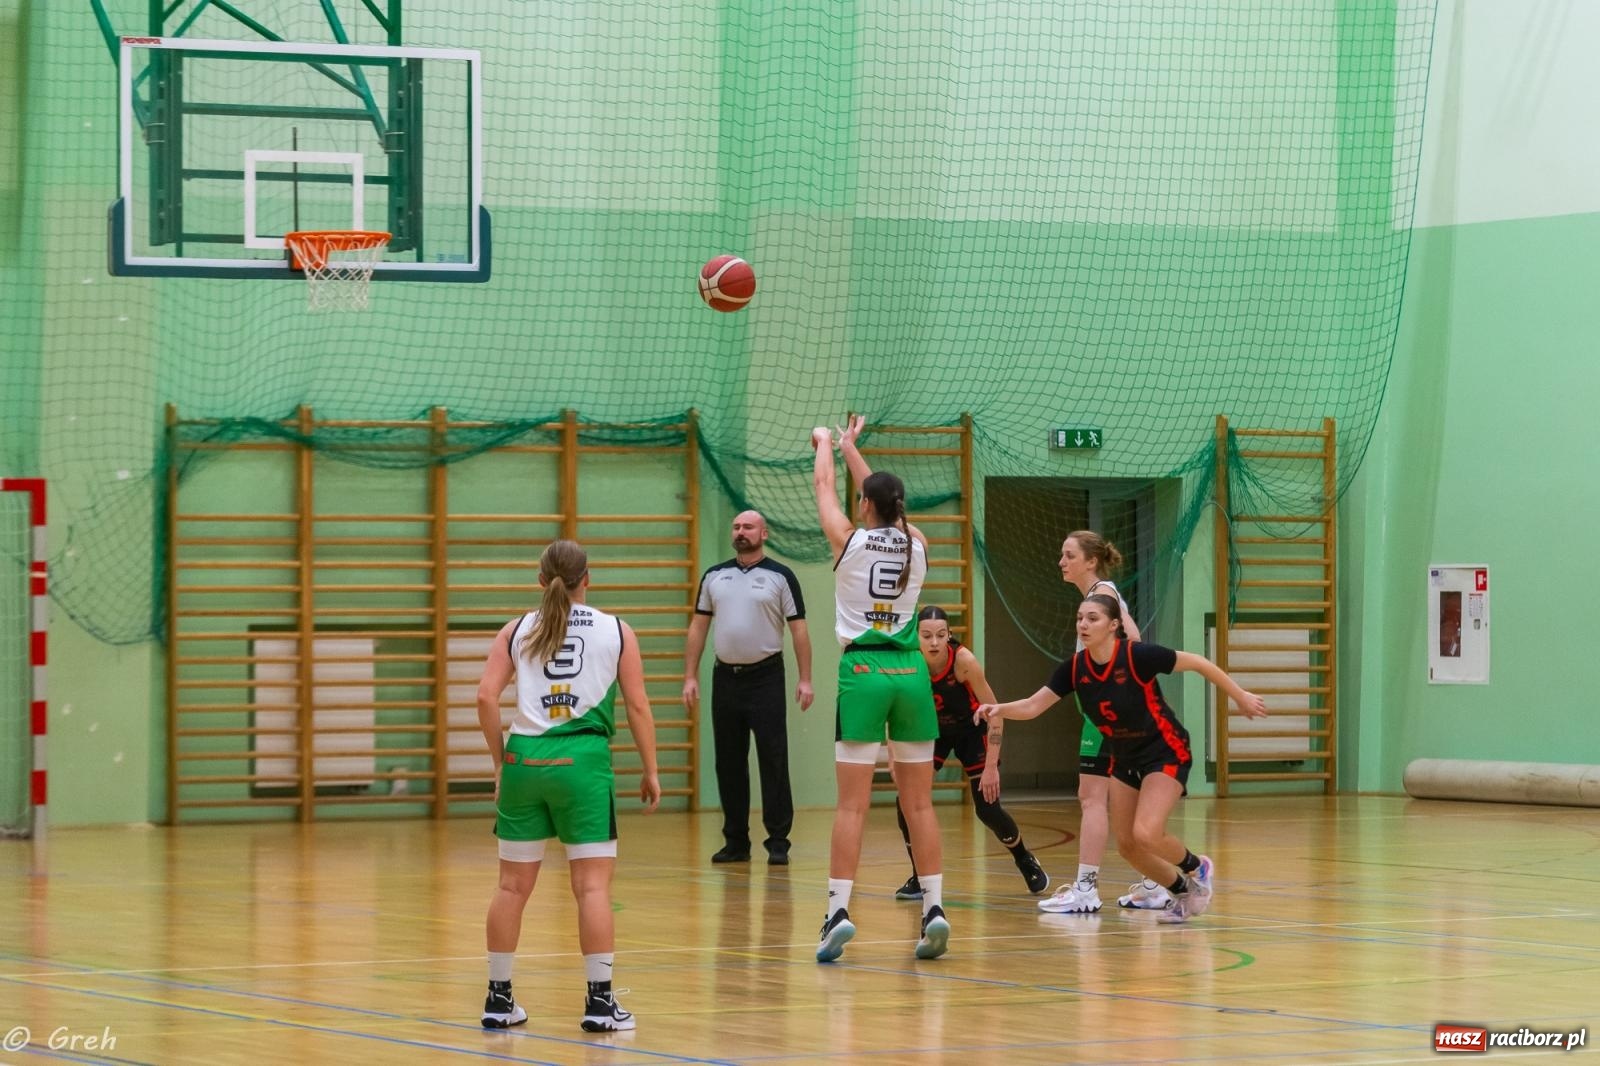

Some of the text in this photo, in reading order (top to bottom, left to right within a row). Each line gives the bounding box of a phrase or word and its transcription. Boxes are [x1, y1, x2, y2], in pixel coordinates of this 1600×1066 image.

[865, 543, 908, 554] RACIBÓR
[868, 560, 905, 600] 6
[544, 635, 585, 680] 3
[1099, 701, 1118, 721] 5
